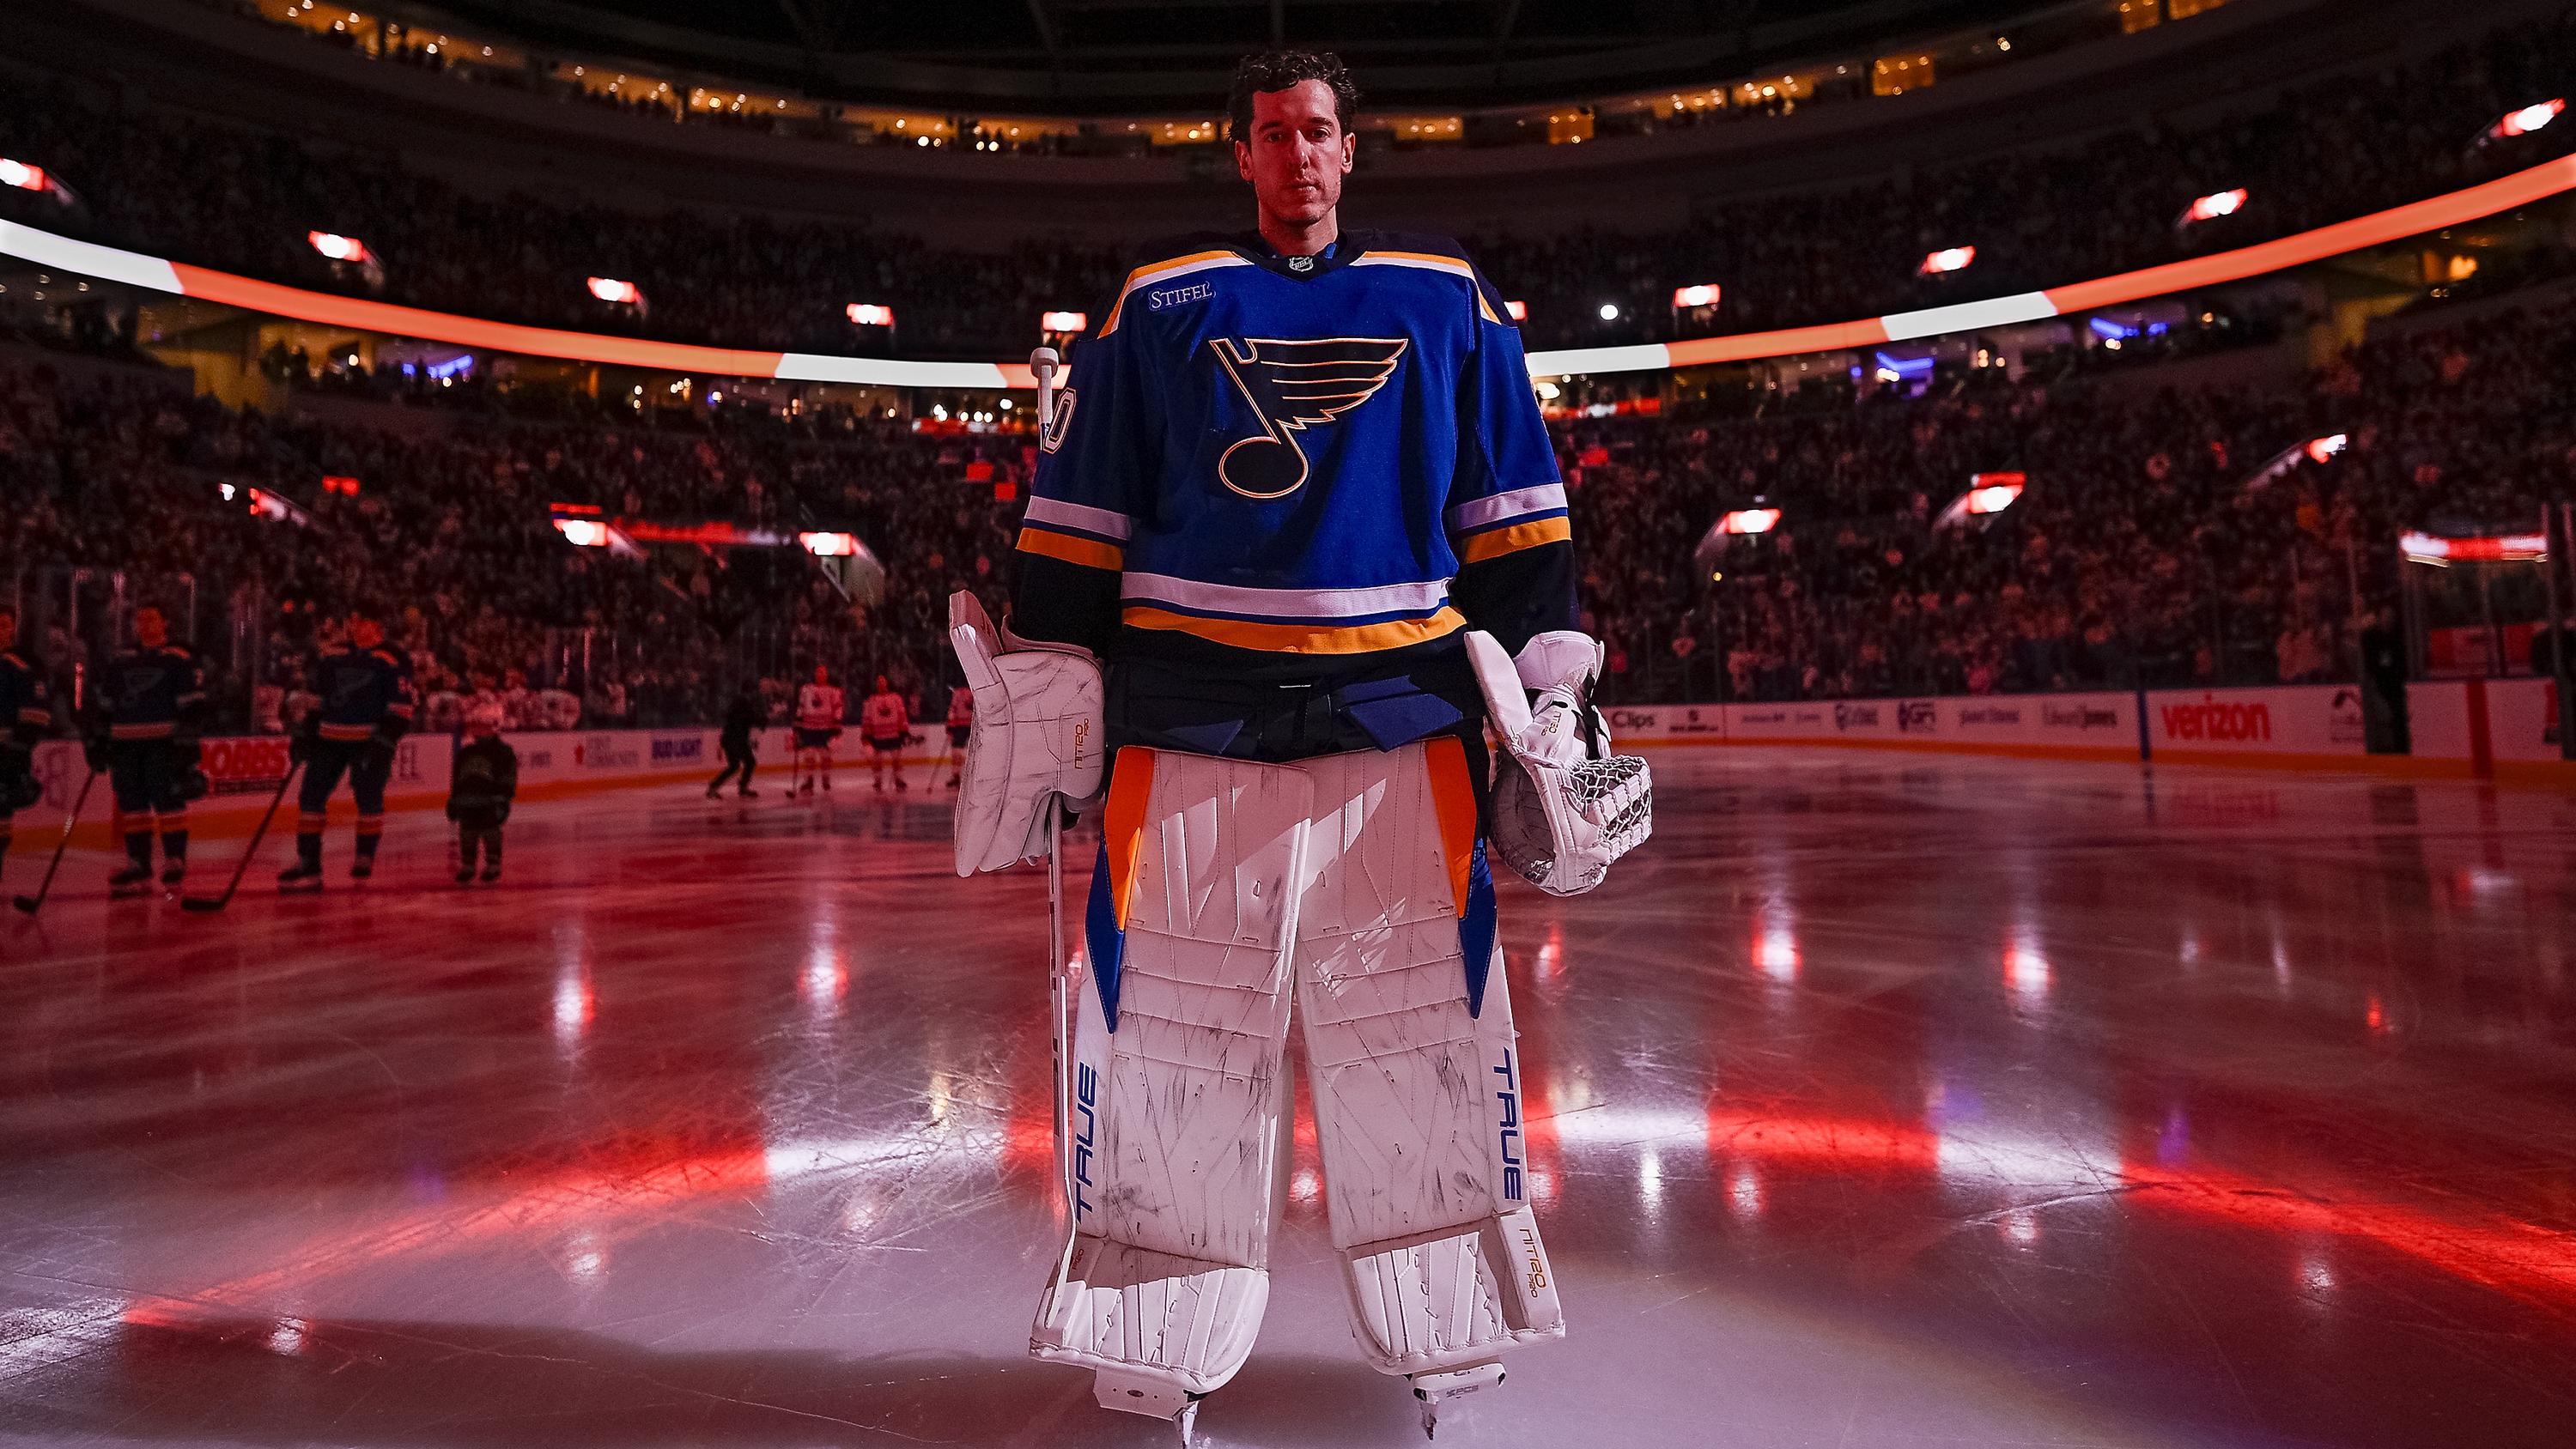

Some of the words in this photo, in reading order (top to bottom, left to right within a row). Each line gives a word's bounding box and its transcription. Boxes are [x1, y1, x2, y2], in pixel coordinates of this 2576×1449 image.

[1151, 283, 1212, 309] STIFEL
[1612, 711, 1656, 732] Clips
[2161, 693, 2271, 741] verizon
[1074, 724, 1084, 769] NITRO
[1076, 1062, 1097, 1225] TRUE
[1493, 1047, 1522, 1201] TRUE
[1519, 1228, 1546, 1288] NITRO
[1527, 1273, 1539, 1298] PRO
